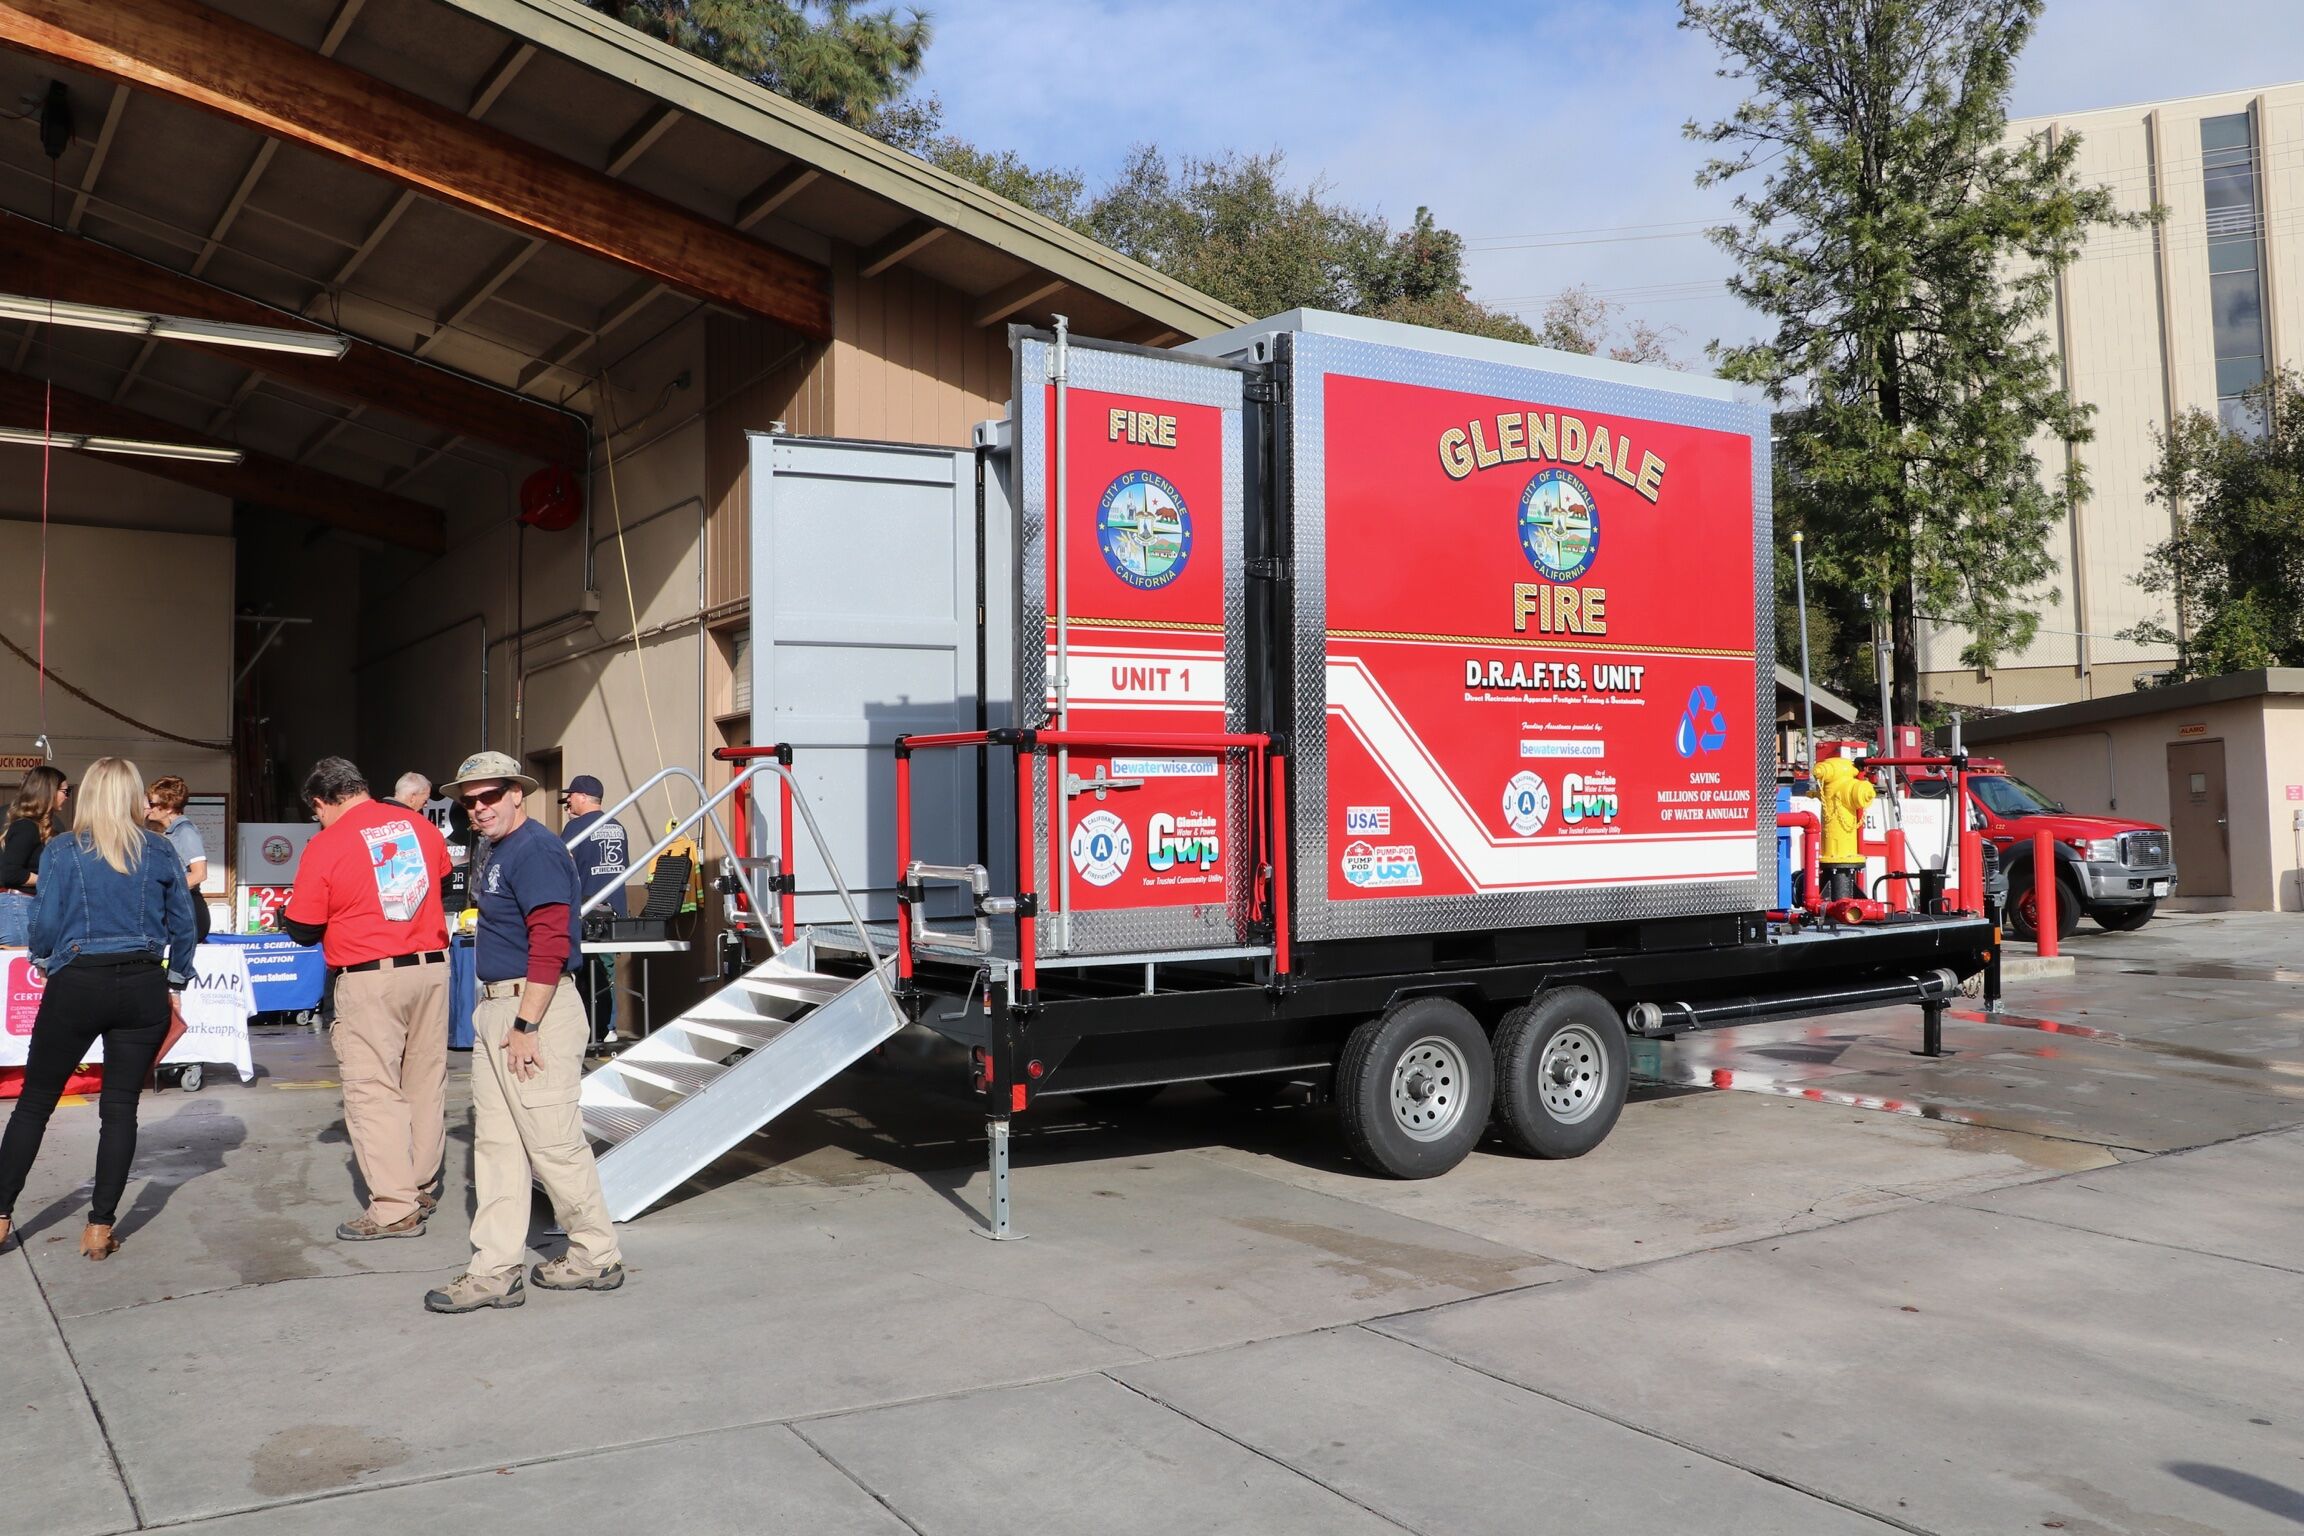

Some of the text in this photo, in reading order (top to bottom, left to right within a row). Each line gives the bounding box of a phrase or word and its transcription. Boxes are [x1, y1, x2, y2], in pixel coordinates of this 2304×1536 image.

[1108, 408, 1177, 448] FIRE
[1438, 412, 1667, 504] GLENDALE
[1101, 472, 1188, 516] CITY OF GLENDALE
[1521, 470, 1596, 512] CITY OF GLENDALE
[1115, 565, 1177, 588] CALIFORNIA
[1533, 559, 1586, 581] CALIFORNIA
[1513, 582, 1607, 635] FIRE
[1111, 666, 1189, 692] UNIT 1
[1465, 659, 1645, 692] D.R.A.F.T.S. UNIT
[1522, 743, 1601, 755] bewaterwise.com
[16, 757, 42, 768] ROOM
[1113, 760, 1214, 774] bewaterwise.com
[1689, 772, 1720, 784] SAVING
[1505, 793, 1548, 811] J A C
[1657, 790, 1750, 802] MILLIONS OF GALLONS
[1087, 815, 1116, 825] CALIFORNIA
[1176, 815, 1217, 828] Glendale
[1348, 813, 1378, 829] USA
[1661, 807, 1749, 820] OF WATER ANNUALLY
[1176, 827, 1216, 836] Water & Power
[599, 839, 624, 866] 13
[1073, 836, 1129, 857] J A C
[1376, 847, 1414, 856] PUMP-POD
[1376, 855, 1420, 879] USA
[1142, 873, 1223, 886] Your Trusted Community Utility
[244, 955, 295, 965] PORATION
[267, 973, 298, 982] Solutions
